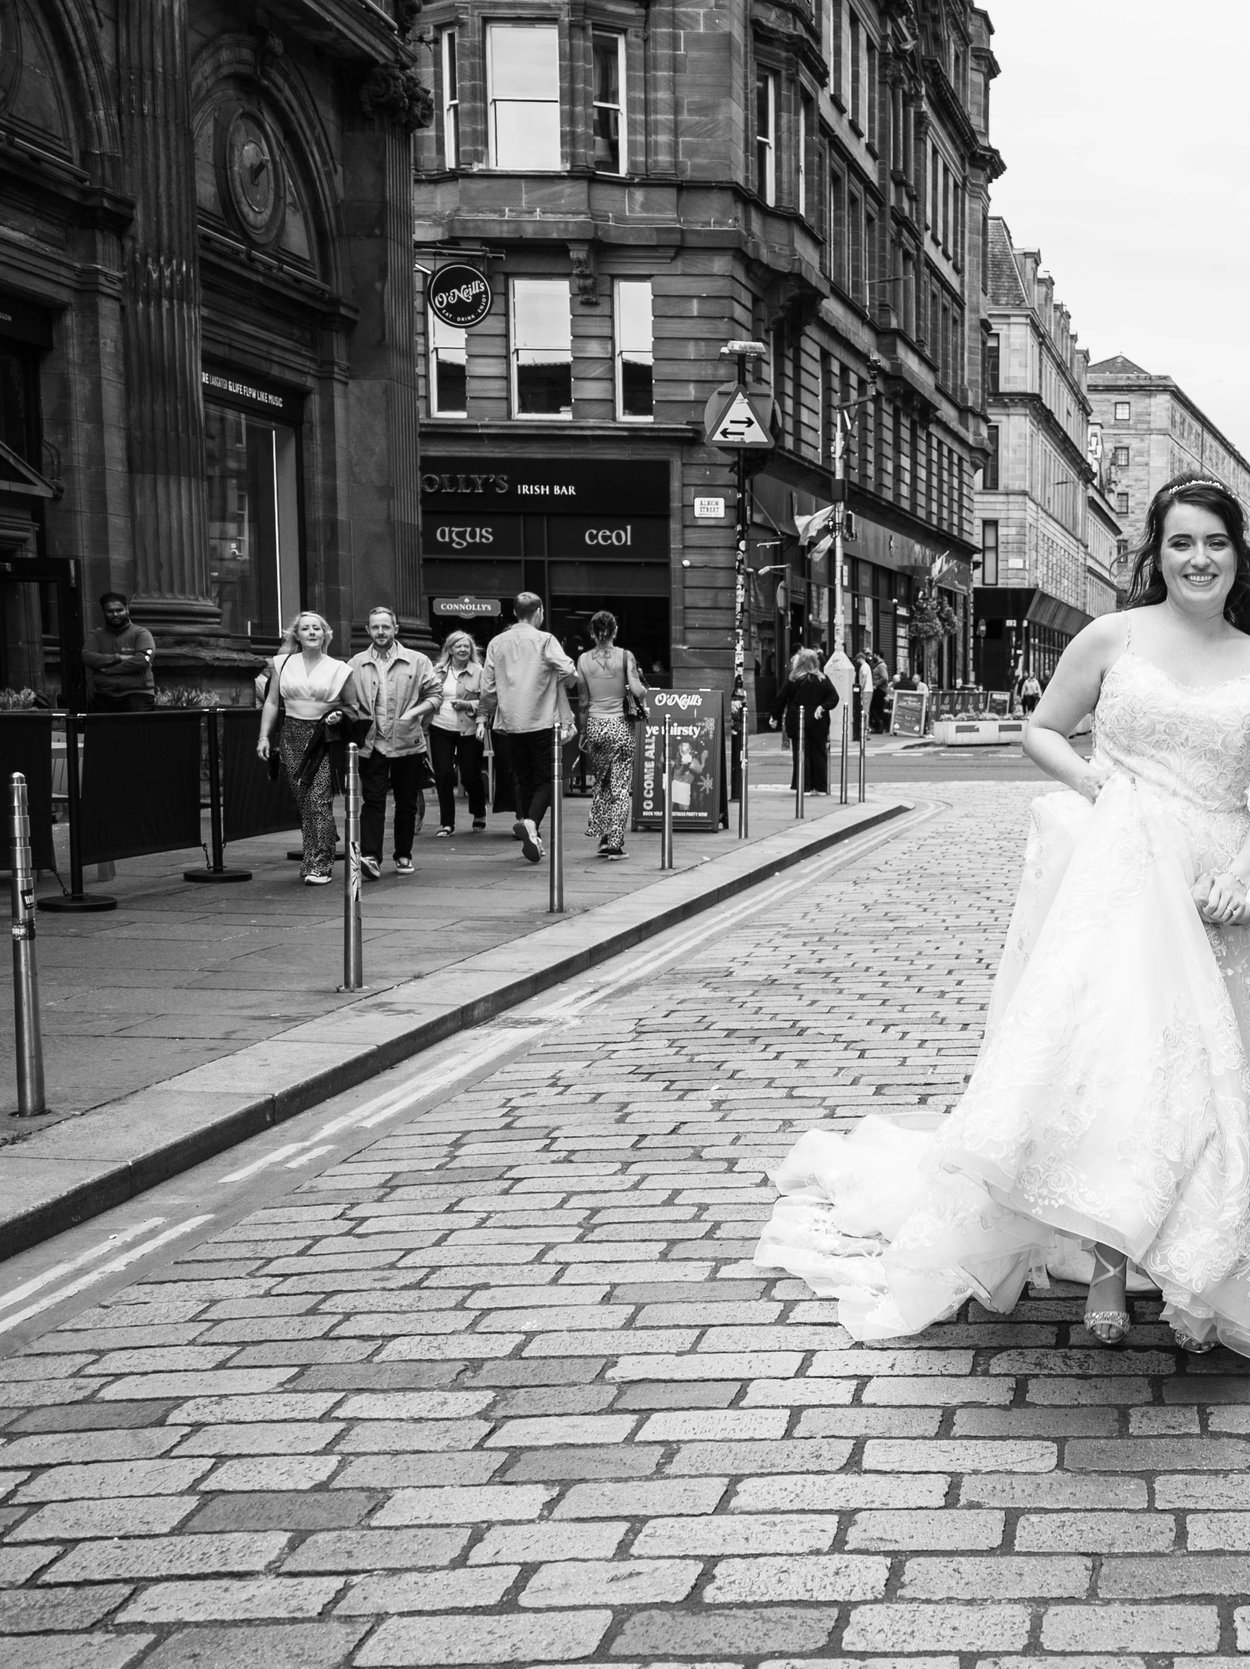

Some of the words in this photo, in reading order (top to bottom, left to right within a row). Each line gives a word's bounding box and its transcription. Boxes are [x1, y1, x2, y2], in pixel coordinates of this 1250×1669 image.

[435, 280, 485, 308] O'Neill's
[421, 473, 509, 493] OLLY'S
[517, 485, 550, 495] IRISH
[553, 485, 577, 496] BAR
[584, 524, 632, 546] ceol
[654, 693, 702, 710] O'Neill's
[645, 725, 660, 737] ye
[644, 735, 656, 759] ALL
[643, 761, 655, 798] COME
